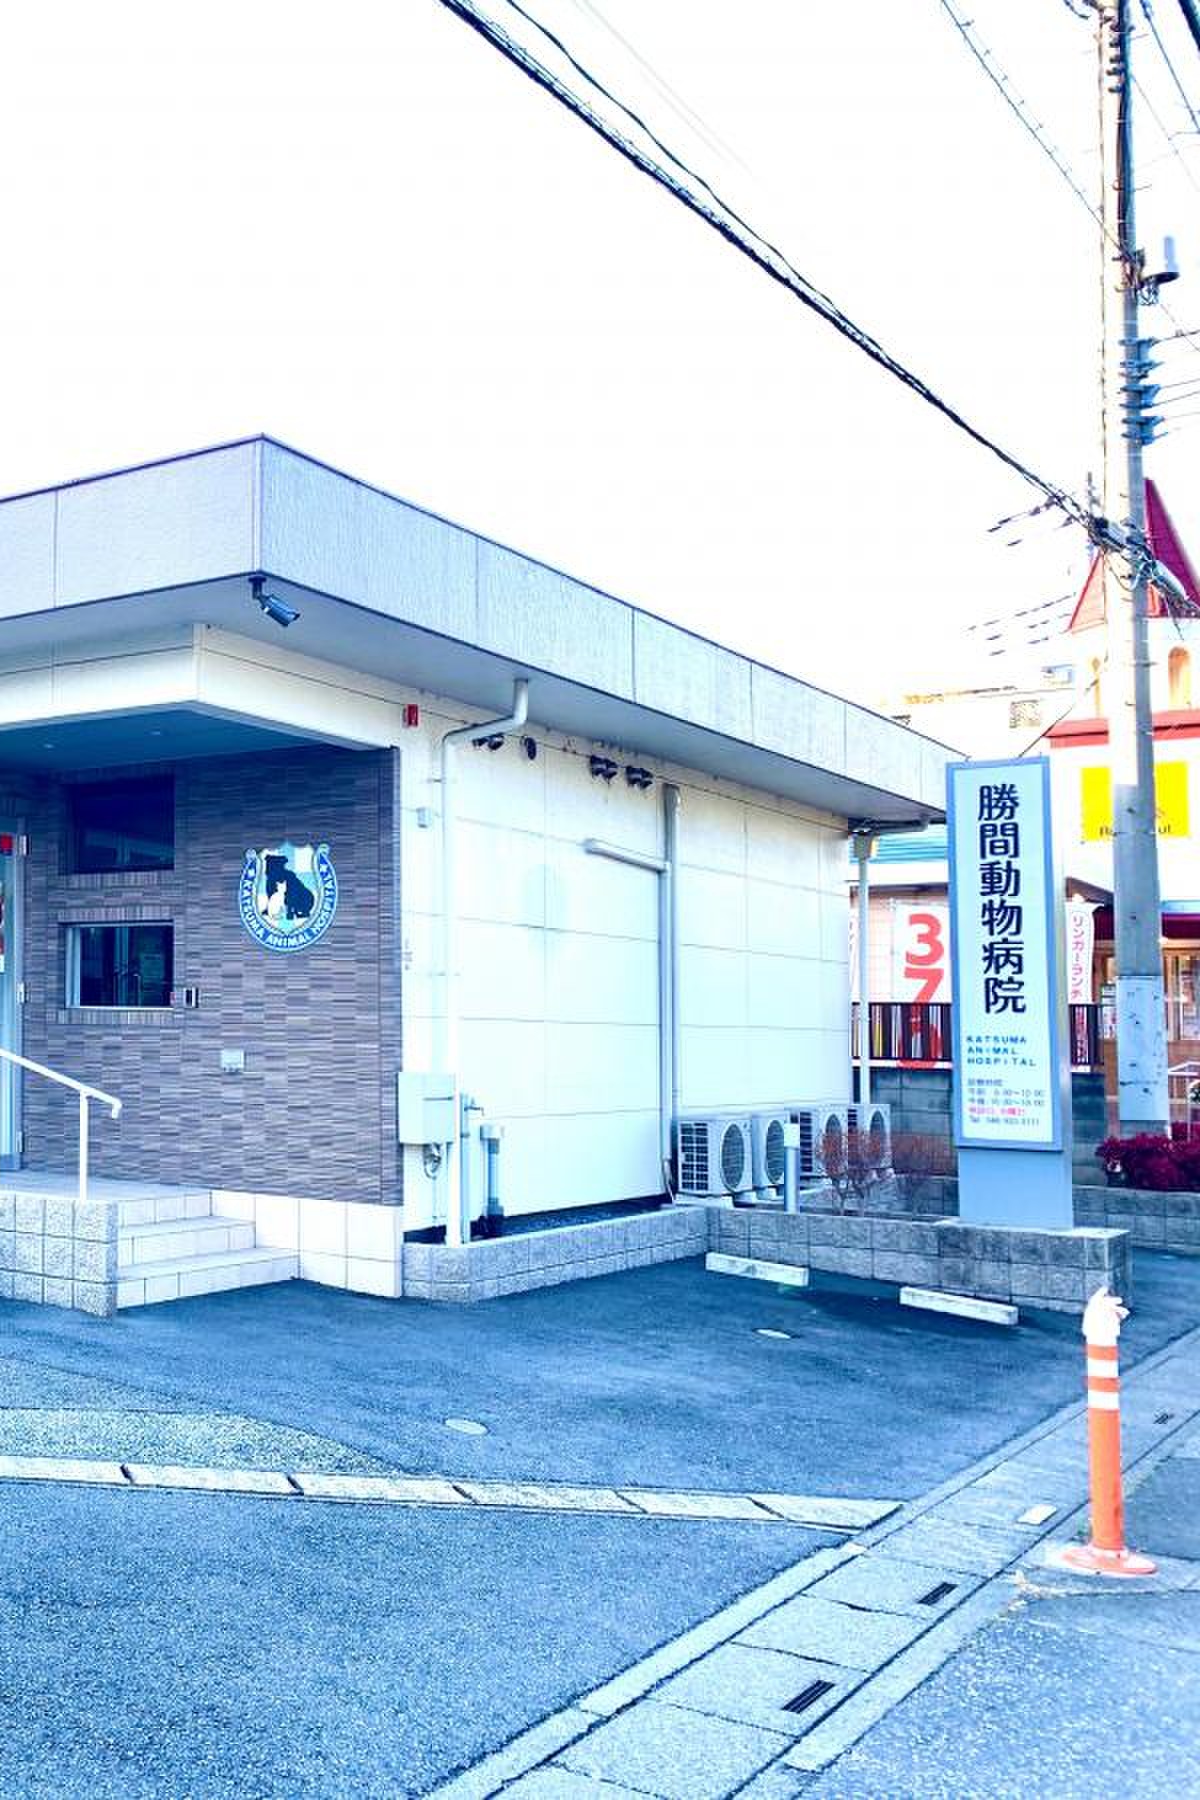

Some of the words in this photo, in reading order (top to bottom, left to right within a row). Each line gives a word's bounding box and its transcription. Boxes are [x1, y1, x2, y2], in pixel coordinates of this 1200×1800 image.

[978, 783, 1026, 1014] 勝間動物病院
[966, 1035, 1027, 1045] KATSUMA
[967, 1046, 1018, 1055] ANIMAL
[967, 1057, 1036, 1067] HOSPITAL
